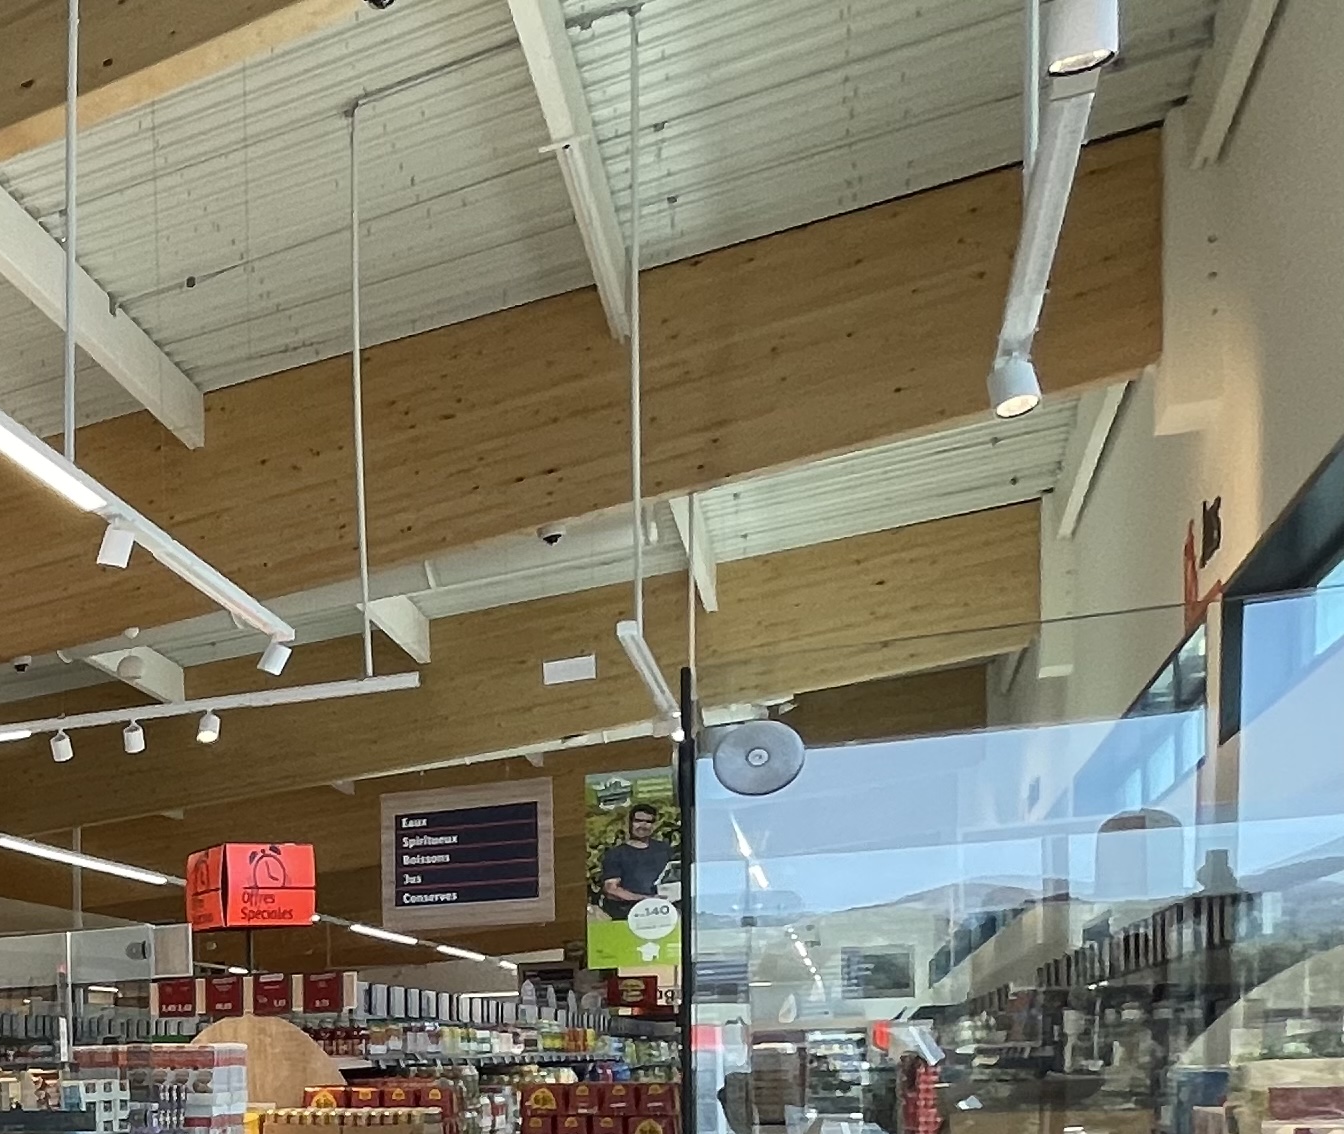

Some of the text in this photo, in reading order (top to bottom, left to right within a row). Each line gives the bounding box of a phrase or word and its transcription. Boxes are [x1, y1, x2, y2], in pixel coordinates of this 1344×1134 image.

[401, 818, 427, 828] Eaux
[402, 834, 458, 849] Spiritueux
[403, 853, 450, 865] Boissons
[403, 874, 422, 885] Jus
[403, 892, 458, 904] Conserves
